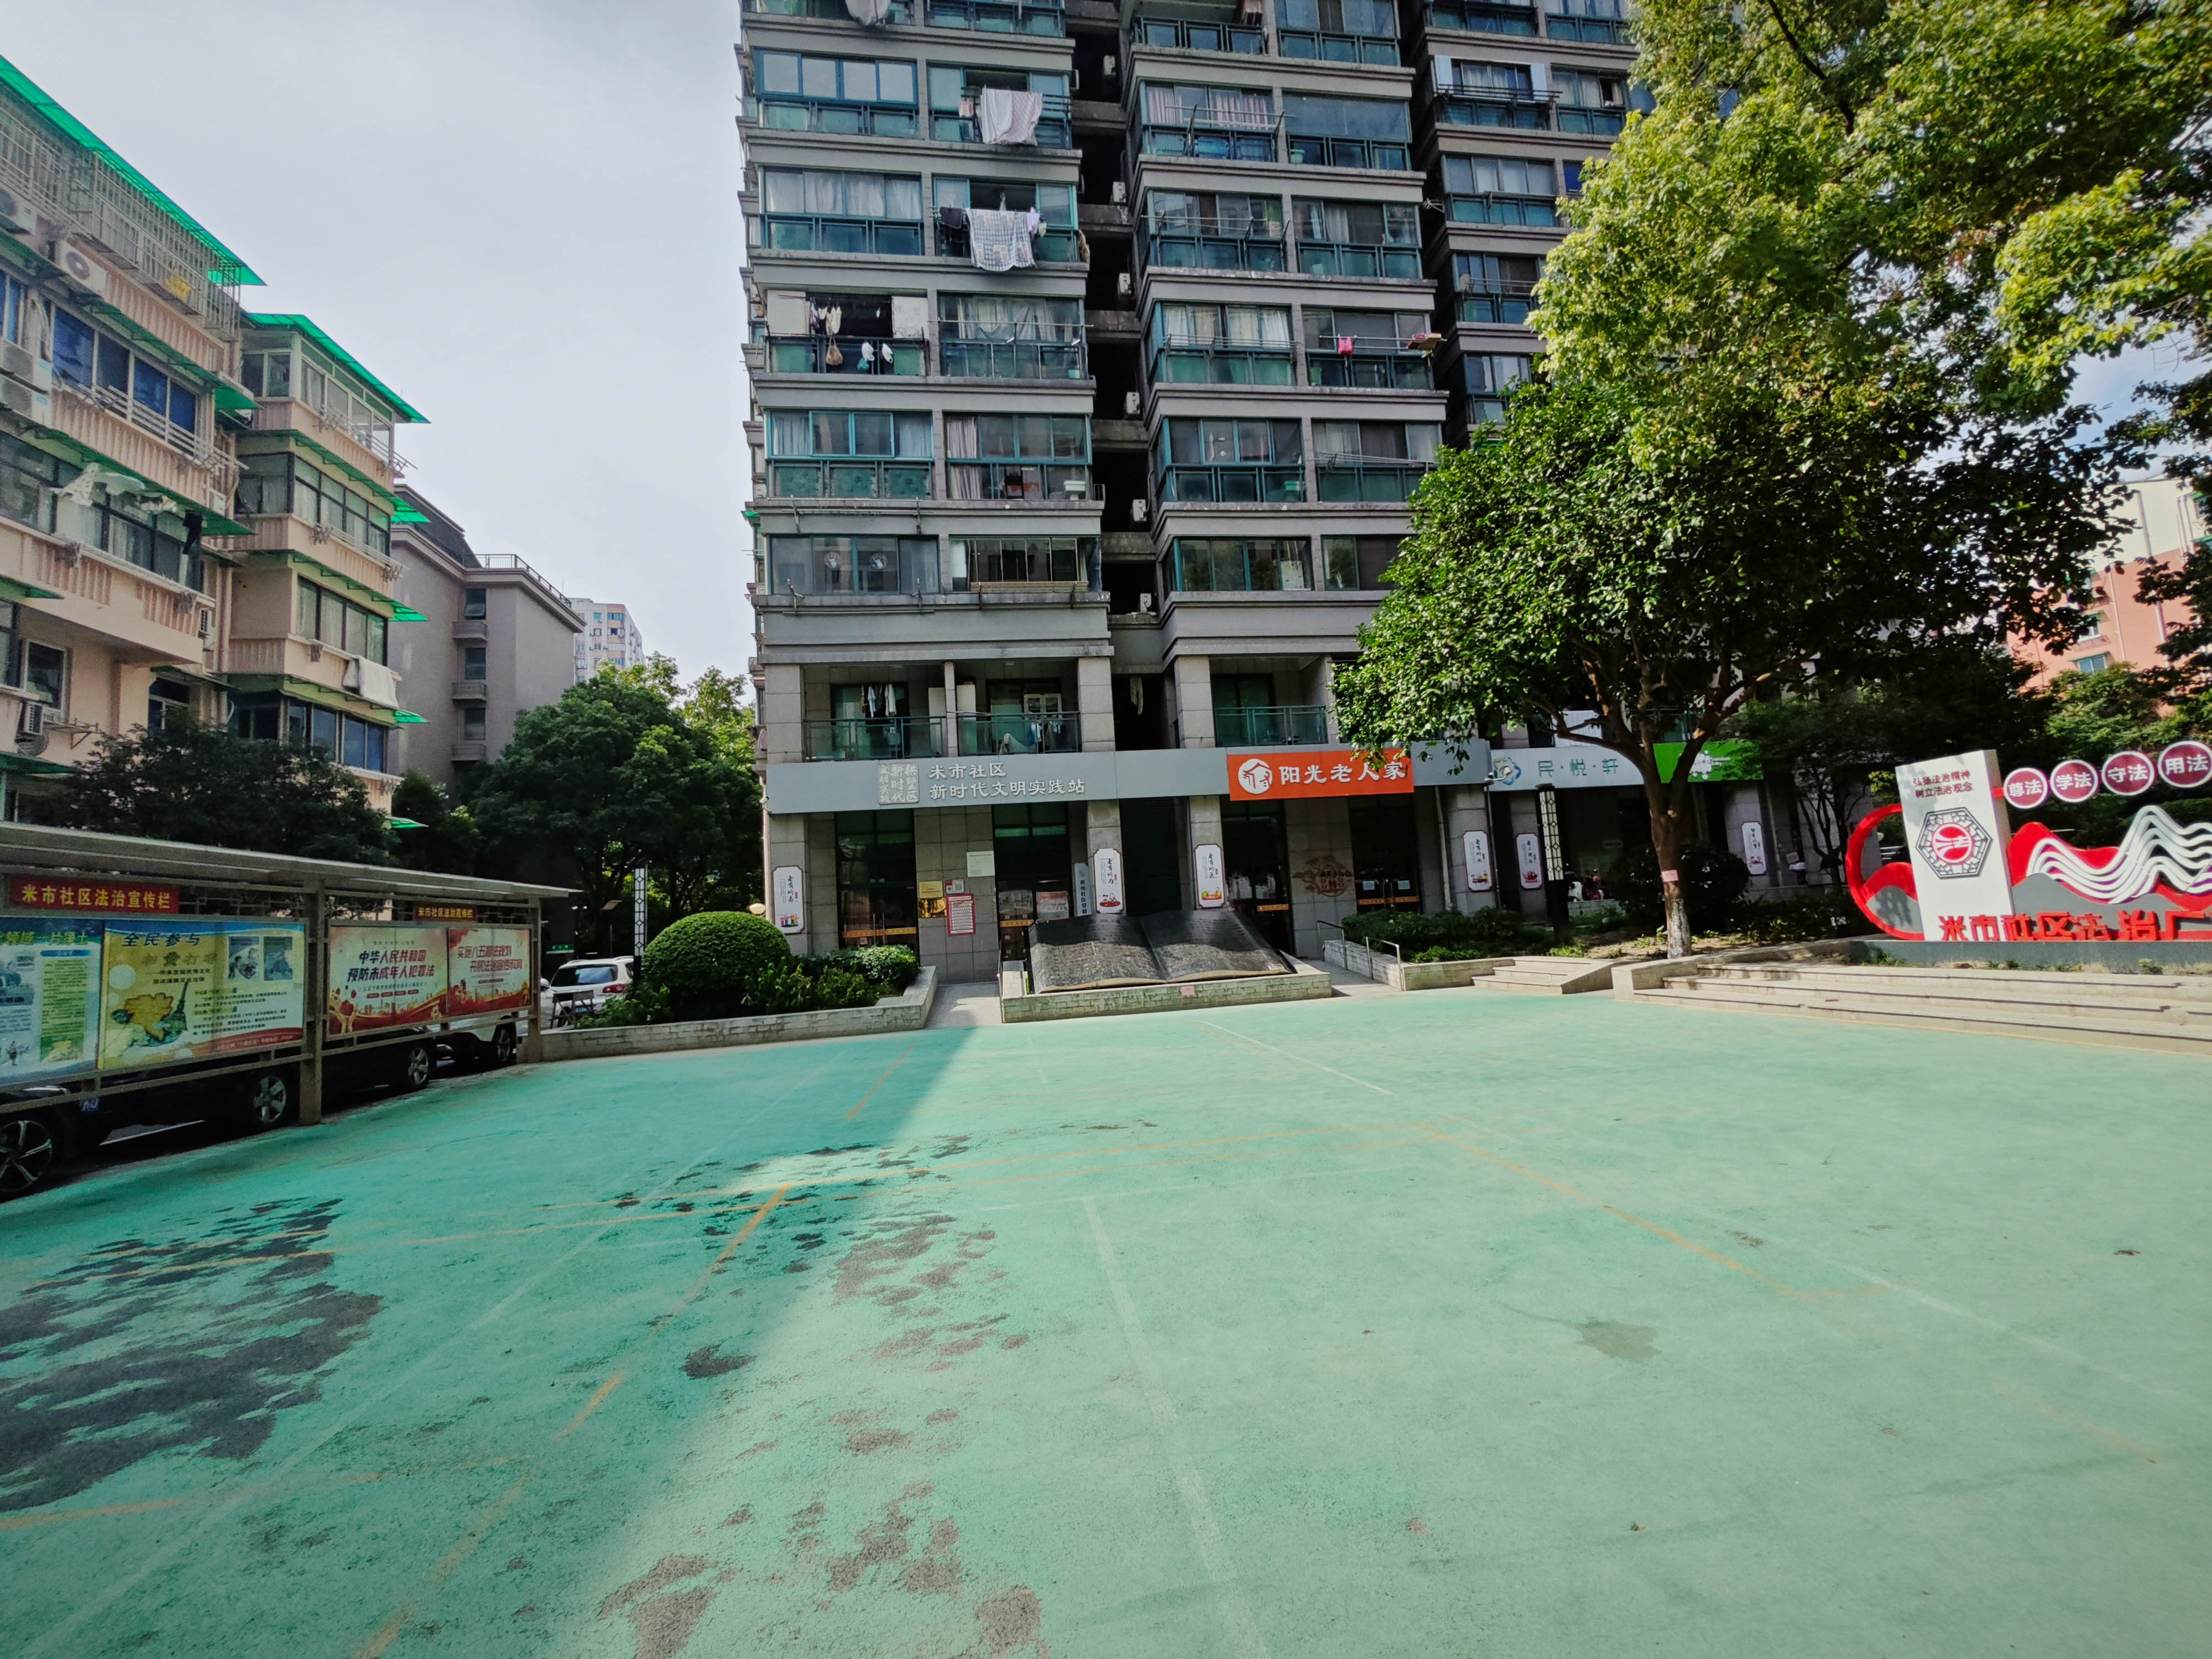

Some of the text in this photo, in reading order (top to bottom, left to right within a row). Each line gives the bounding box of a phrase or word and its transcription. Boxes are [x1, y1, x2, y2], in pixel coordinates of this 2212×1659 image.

[928, 762, 1007, 780] 米市社区
[1279, 761, 1407, 785] 阳光老人家
[2107, 764, 2149, 783] 守法
[2164, 754, 2209, 775] 用法
[1913, 769, 1970, 787] 弘扬法治精神
[2056, 772, 2093, 790] 学法
[928, 779, 1085, 800] 新时代文明实践站
[1916, 781, 1974, 798] 树立法治观念
[2008, 779, 2043, 797] 尊法
[22, 884, 171, 910] 米市社区法治宣传栏
[418, 906, 473, 919] 米市社区法治宣传栏
[122, 932, 201, 947] 全民参与
[359, 950, 427, 964] 中华人民共和国
[347, 964, 435, 982] 预防未成年人犯罪法
